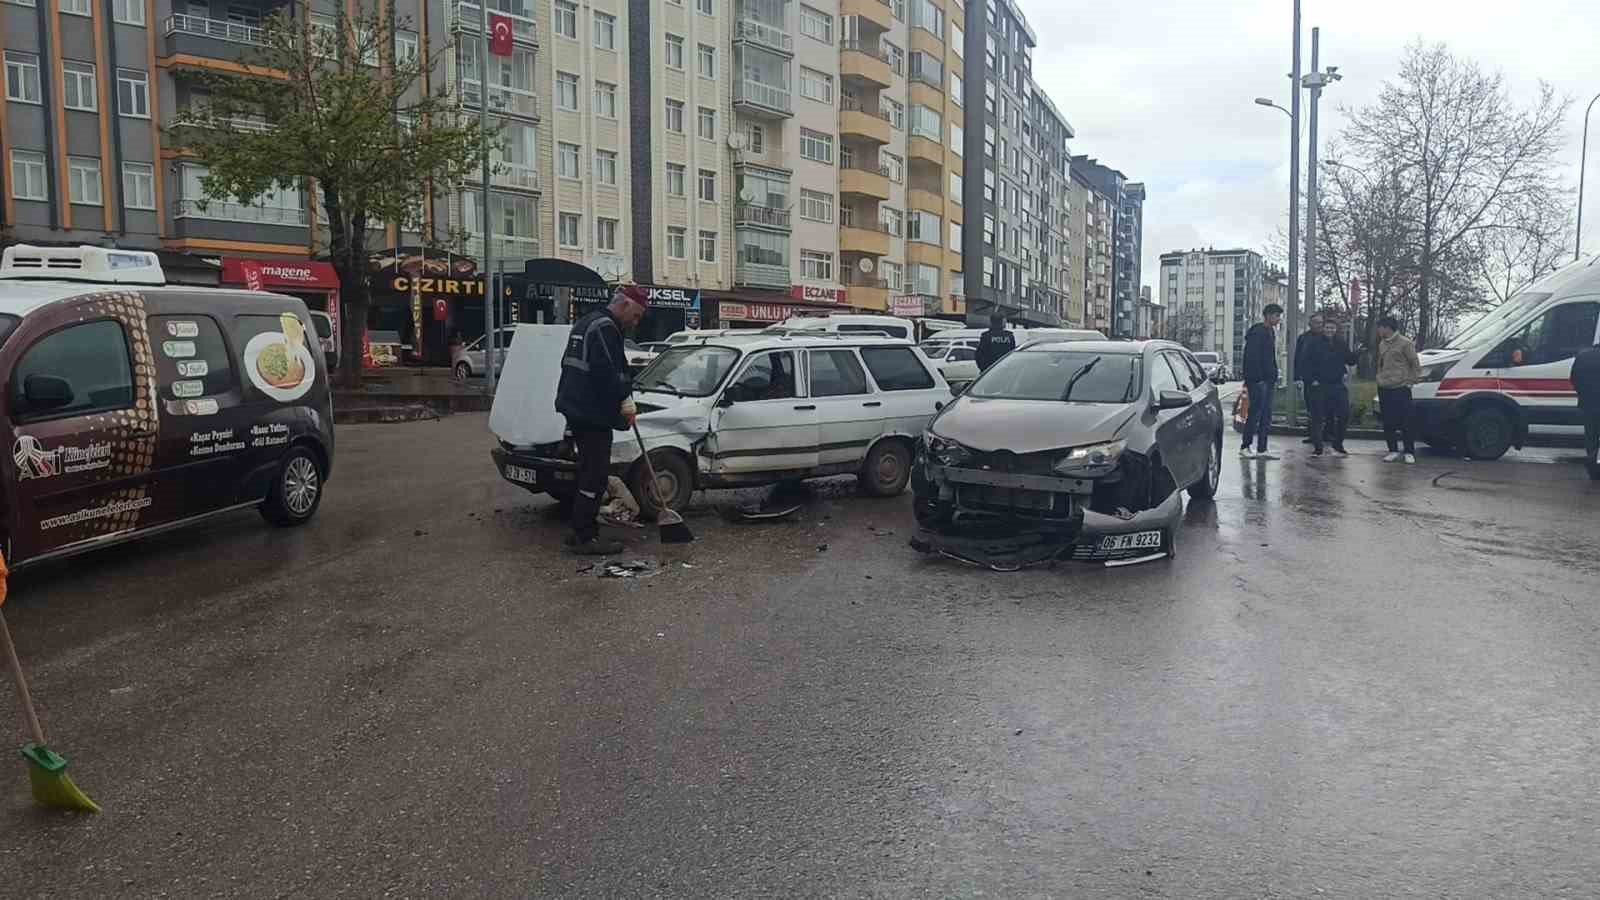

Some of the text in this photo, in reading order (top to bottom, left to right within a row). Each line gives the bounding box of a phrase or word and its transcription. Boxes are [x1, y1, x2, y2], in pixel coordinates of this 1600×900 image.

[805, 287, 836, 299] ECZANE
[1103, 532, 1159, 548] 06 FN 9232
